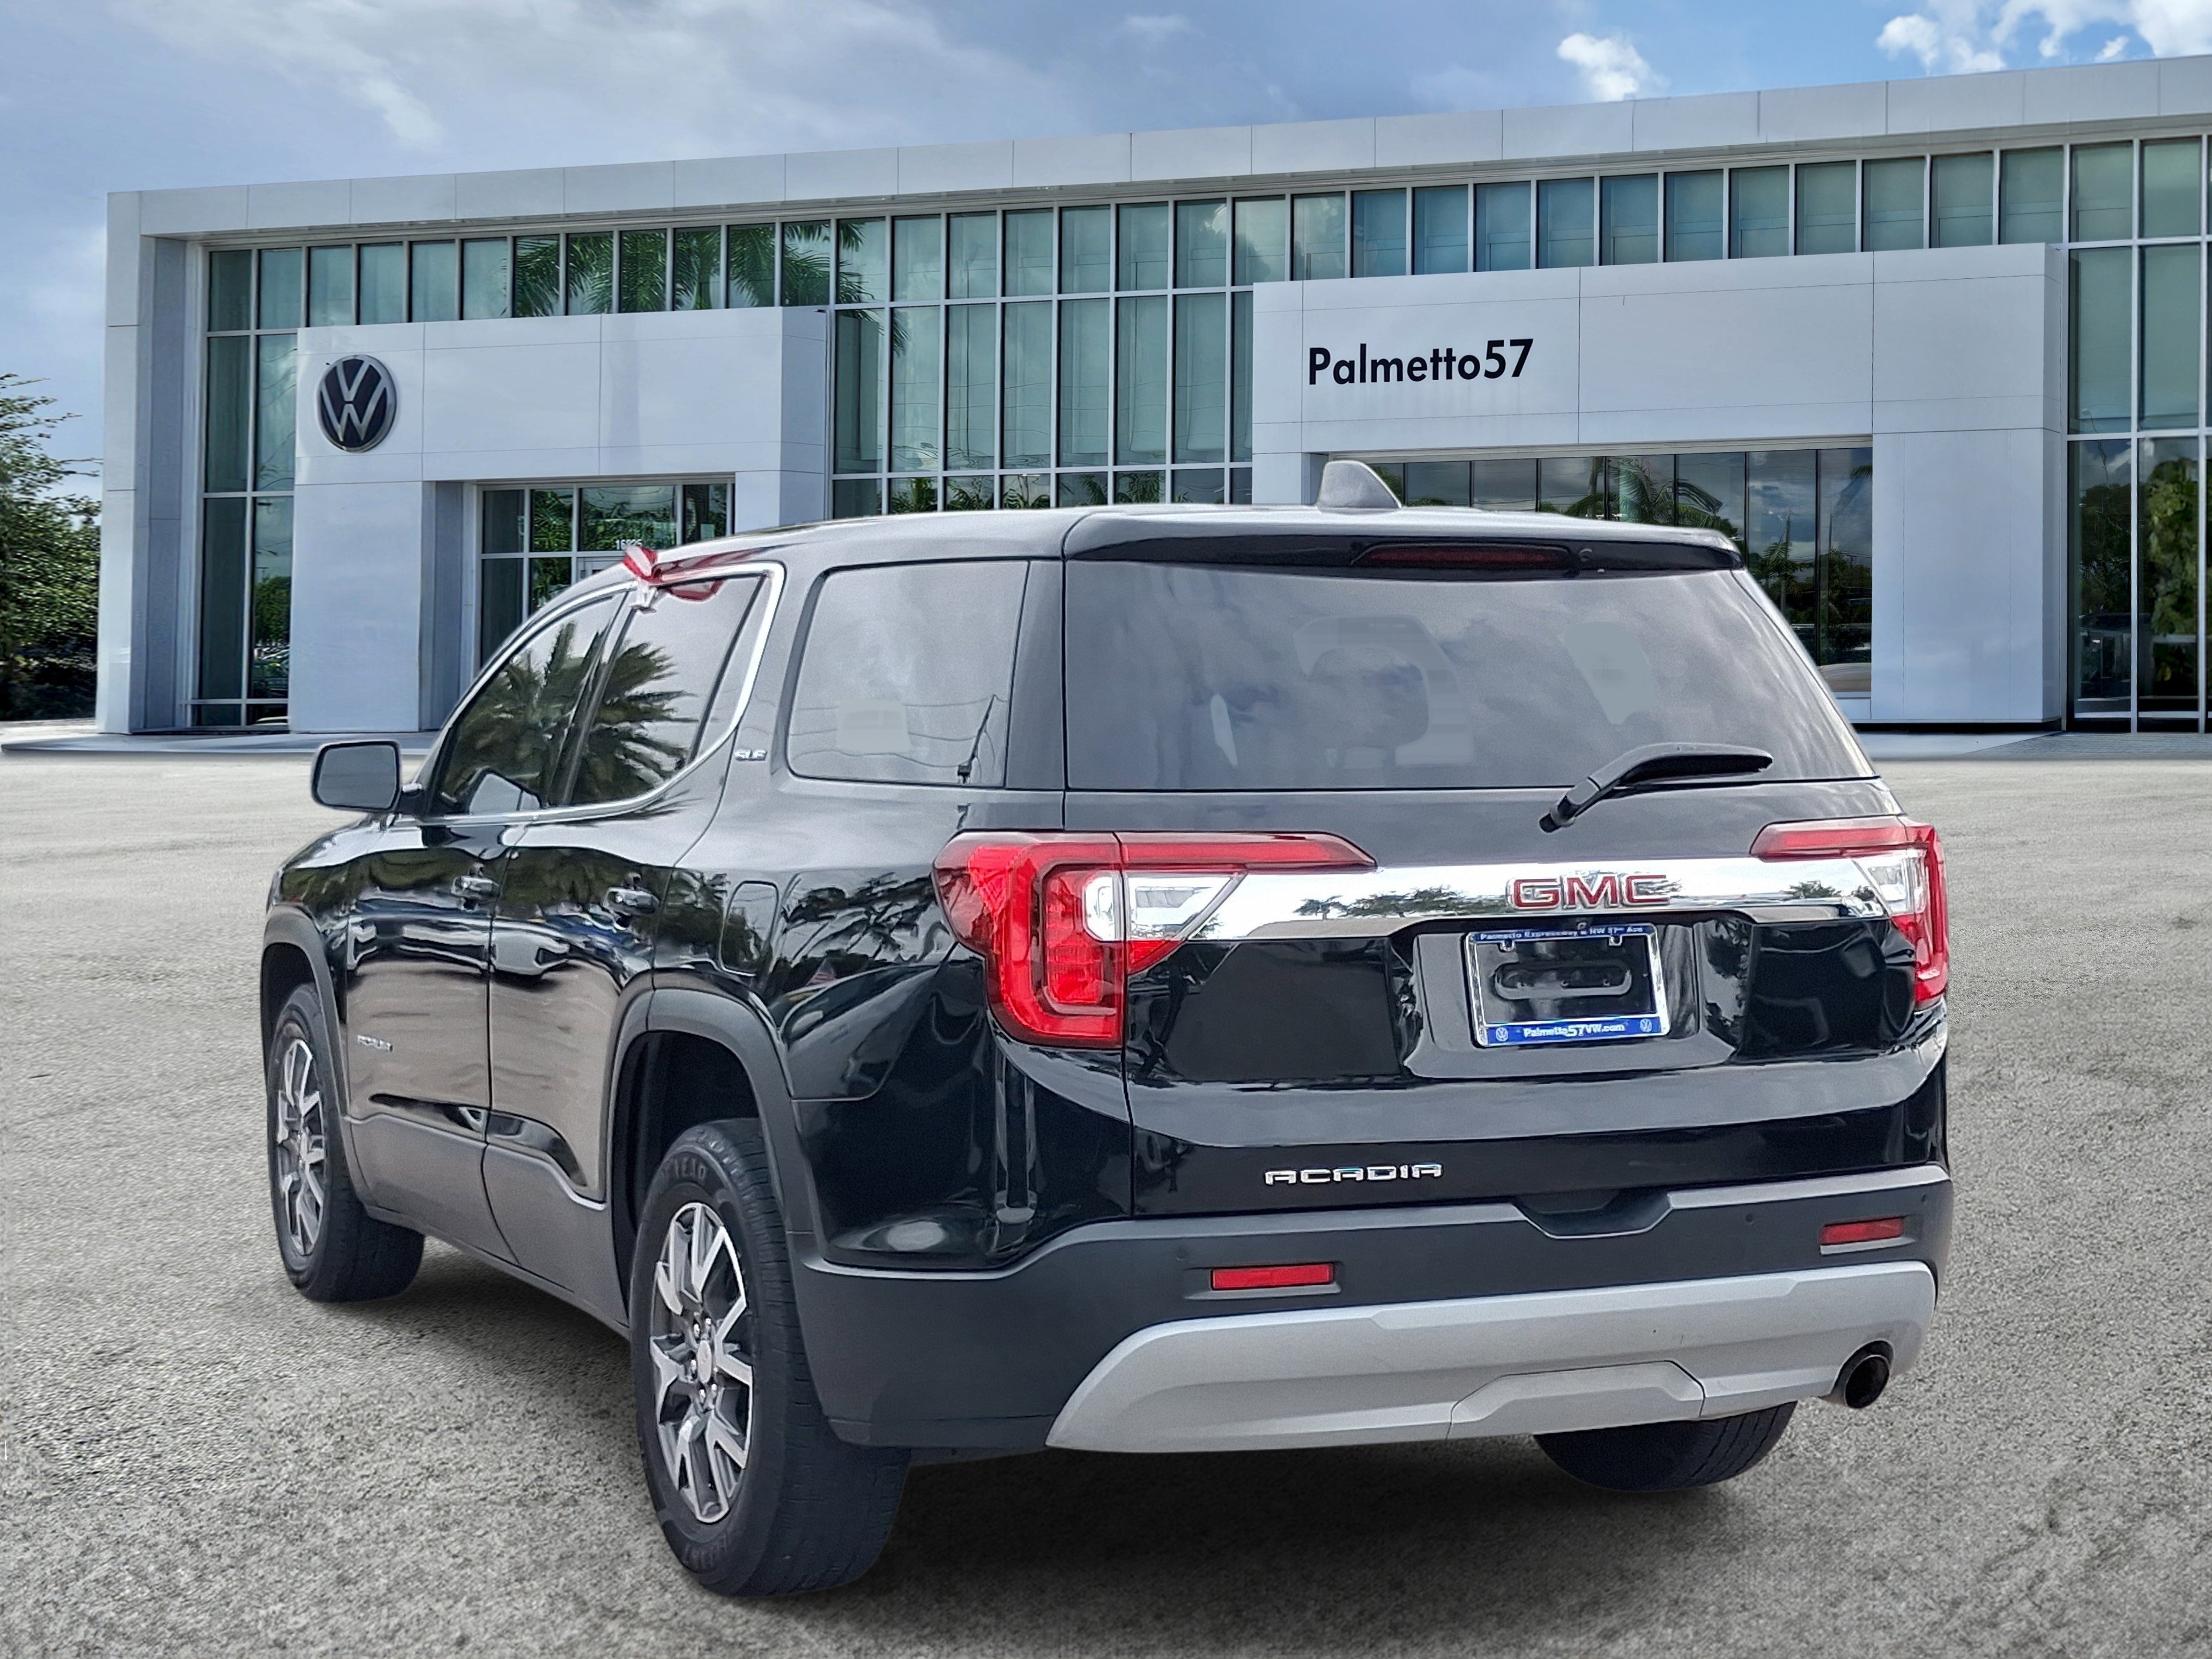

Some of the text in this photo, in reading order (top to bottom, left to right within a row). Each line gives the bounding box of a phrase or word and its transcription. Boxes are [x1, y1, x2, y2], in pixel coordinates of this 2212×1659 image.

[1309, 338, 1534, 385] Palmetto57
[319, 356, 395, 450] VW
[1506, 873, 1670, 909] GMC
[1523, 1023, 1626, 1038] Palmetto57VW.com
[1264, 1164, 1443, 1185] ACADIA
